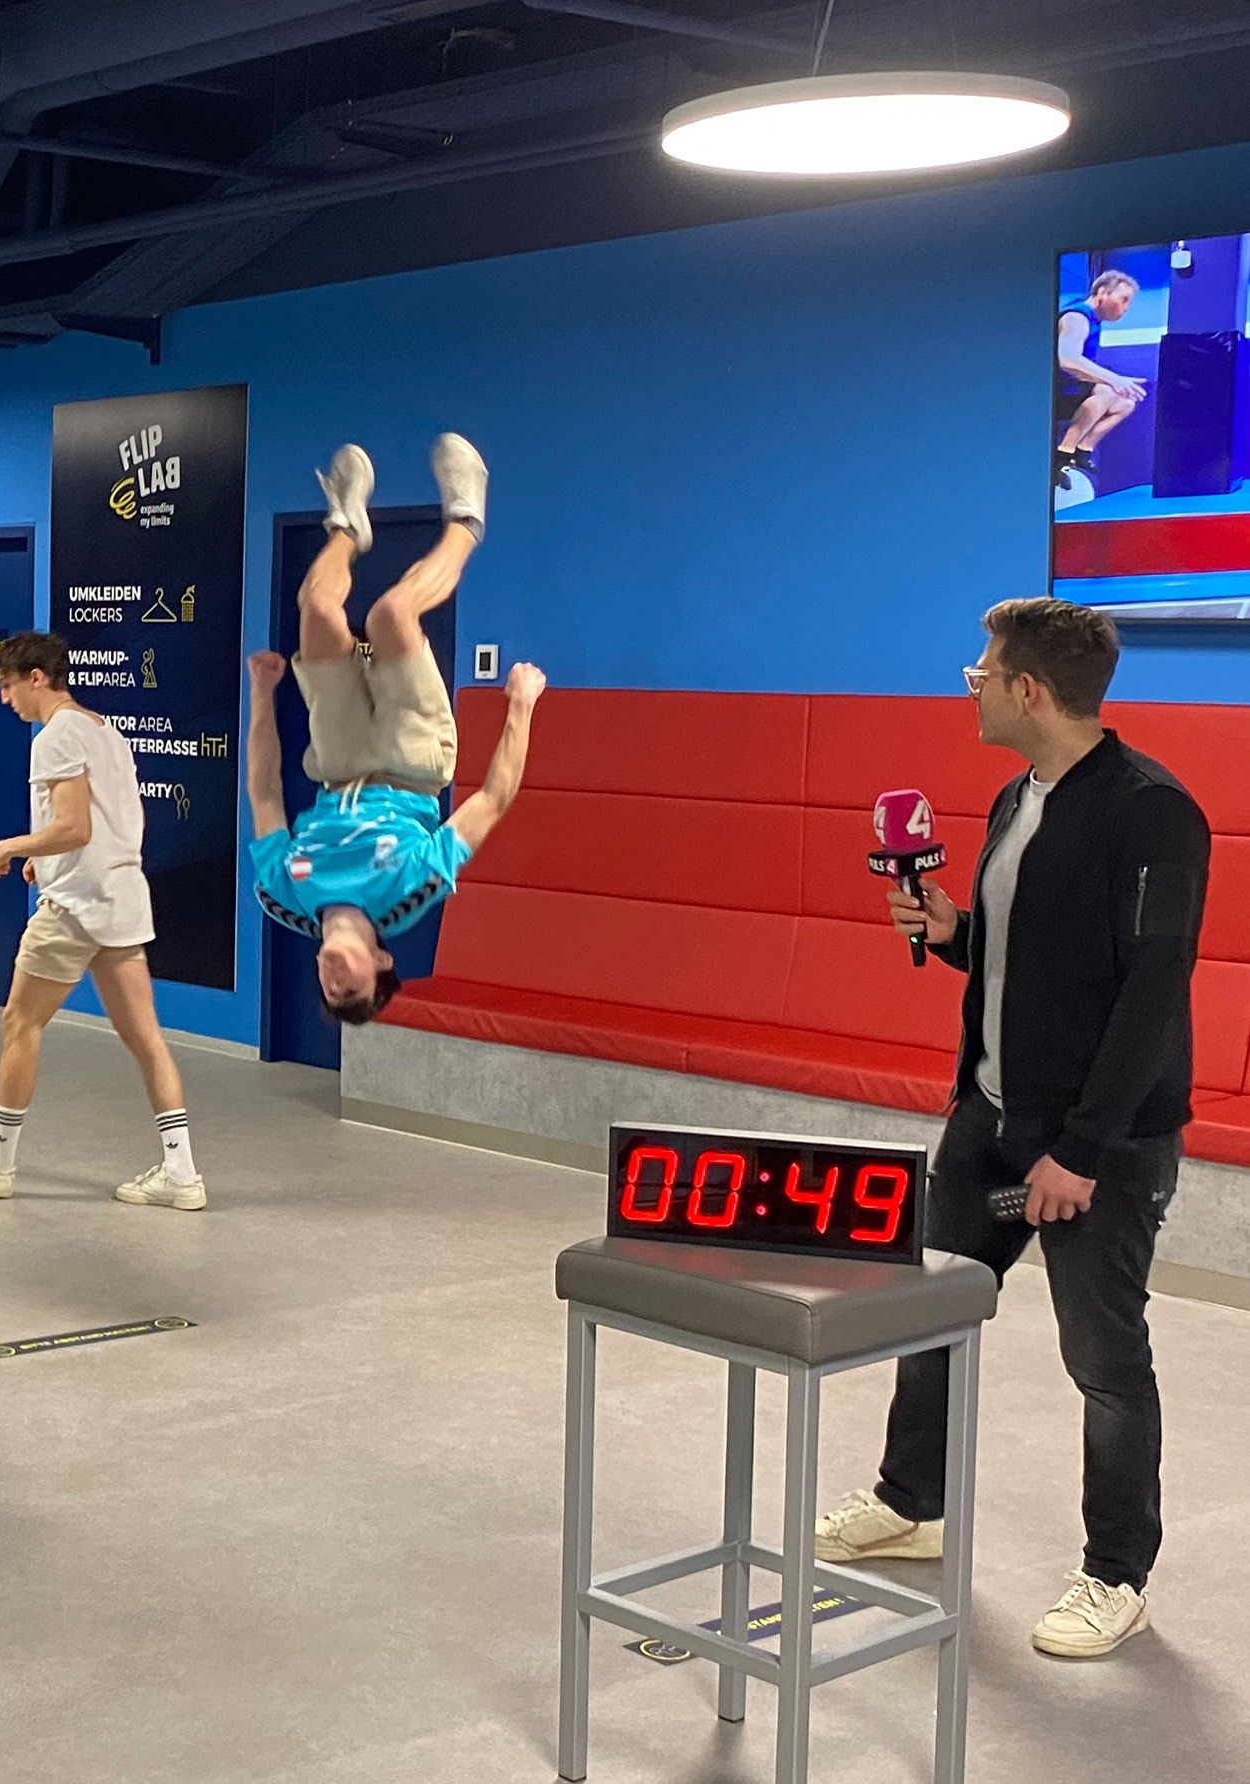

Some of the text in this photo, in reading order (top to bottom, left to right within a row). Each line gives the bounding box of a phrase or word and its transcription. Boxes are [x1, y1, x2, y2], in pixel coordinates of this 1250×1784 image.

[118, 424, 163, 472] FLIP
[137, 456, 181, 498] LAB
[140, 502, 175, 516] expanding
[139, 515, 171, 529] my limits
[69, 585, 142, 602] UMKLEIDEN
[69, 607, 123, 623] LOCKERS
[68, 650, 129, 666] WARMUP-
[68, 671, 136, 688] & FLIPAREA
[138, 716, 173, 733] AREA
[906, 800, 931, 839] 4
[915, 853, 940, 870] PULS
[619, 1147, 909, 1243] 00:49
